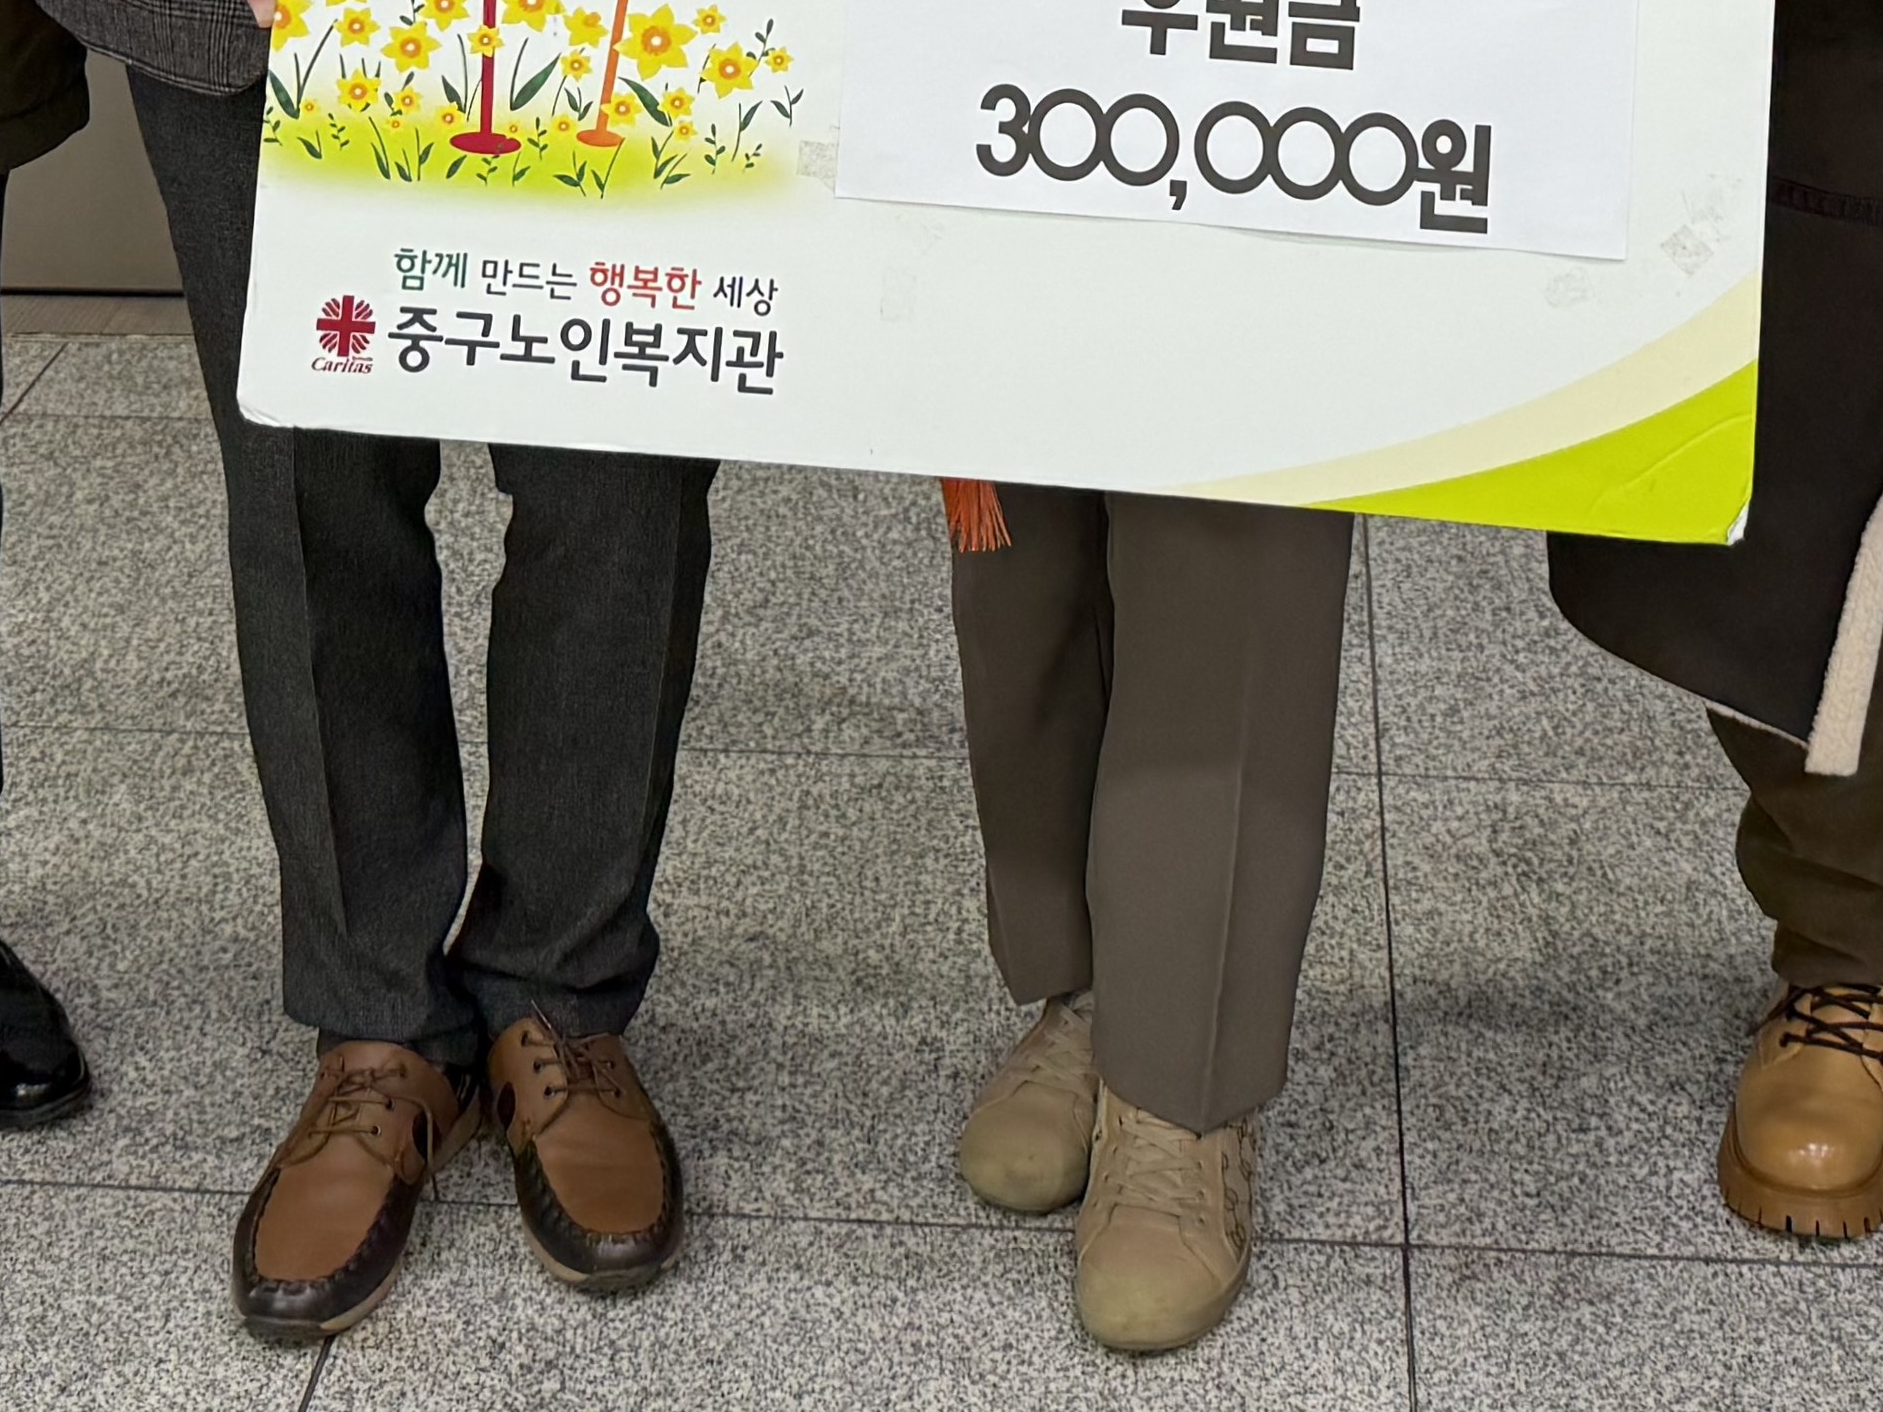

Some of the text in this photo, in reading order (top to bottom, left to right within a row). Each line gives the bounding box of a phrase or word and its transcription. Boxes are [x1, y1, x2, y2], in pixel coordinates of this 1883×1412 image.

[974, 82, 1493, 236] 300,000원
[394, 247, 778, 318] 함께 만드는 행복한 세상
[311, 357, 373, 374] Caritas
[387, 306, 784, 396] 중구노인복지관
